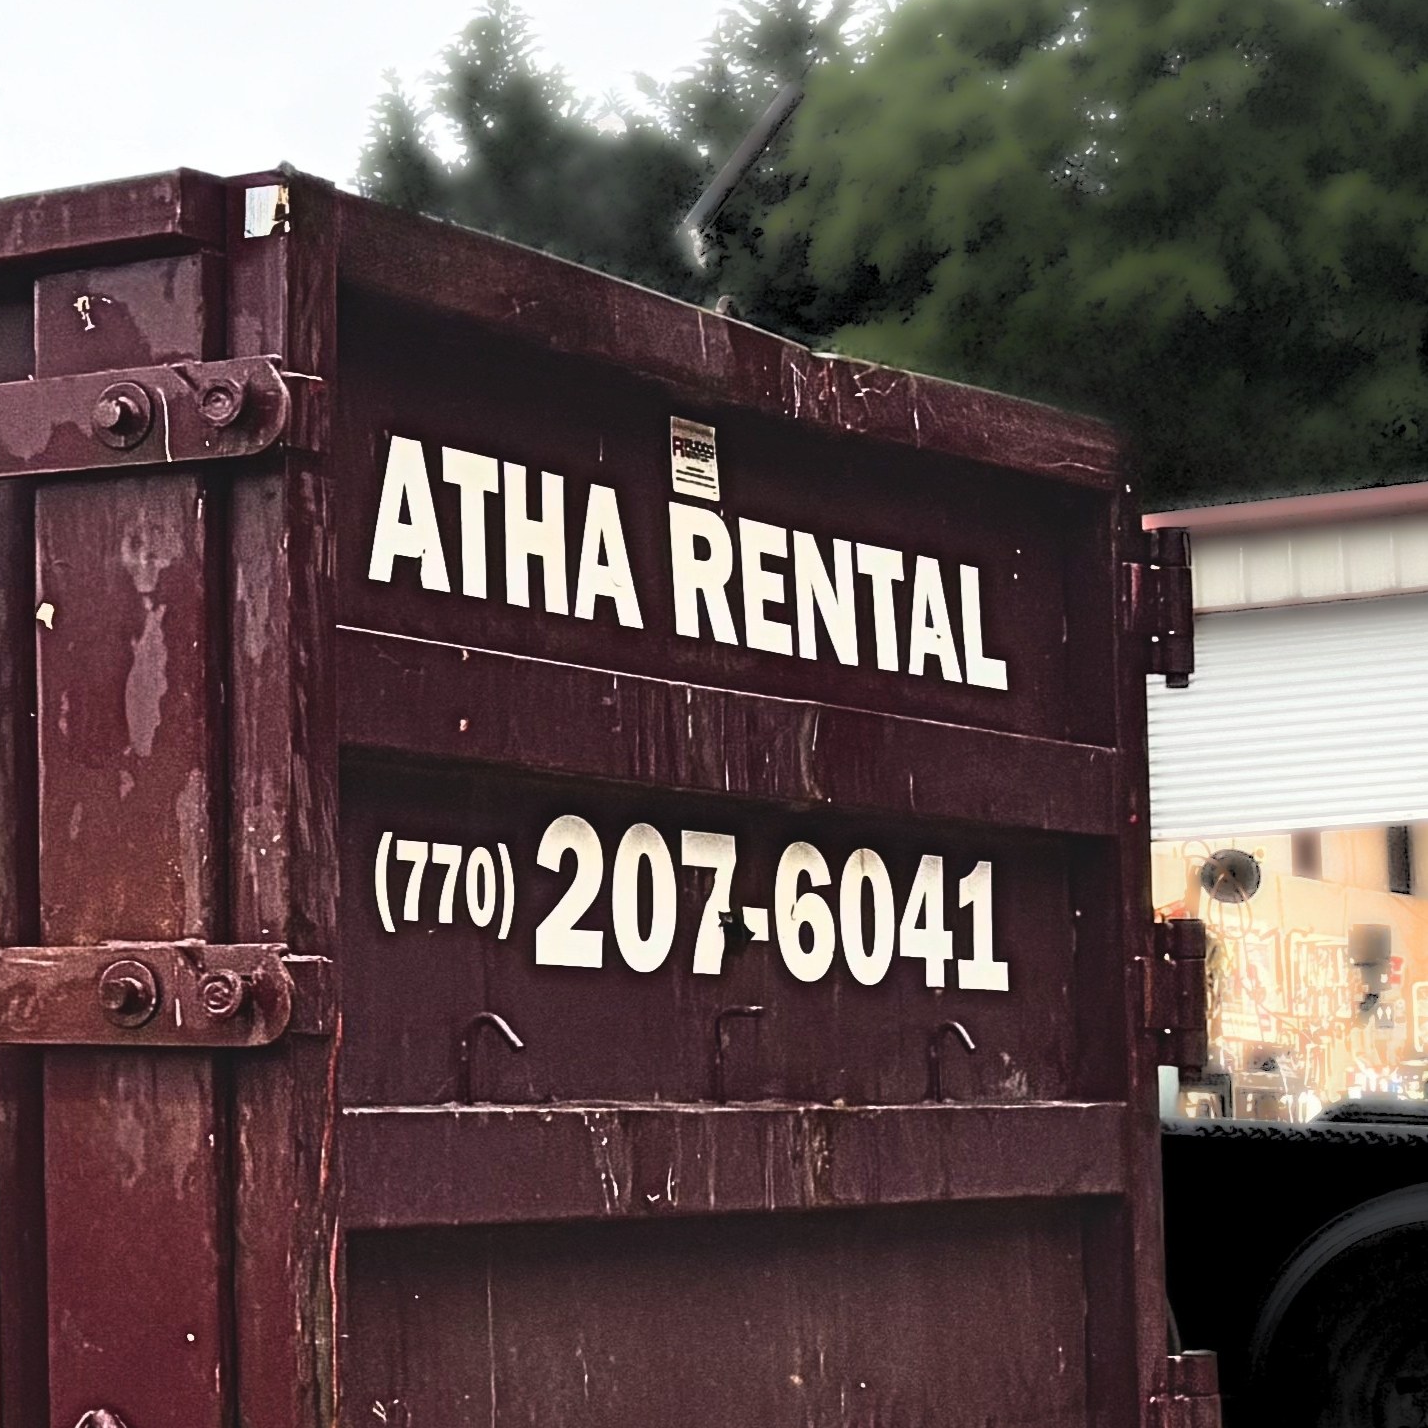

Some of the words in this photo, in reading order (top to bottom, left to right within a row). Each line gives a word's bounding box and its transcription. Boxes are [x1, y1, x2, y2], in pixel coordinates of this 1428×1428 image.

[369, 436, 643, 629] ATHA
[669, 502, 1007, 690] RENTAL
[375, 832, 515, 940] (770)
[535, 815, 1009, 992] 207-6041
